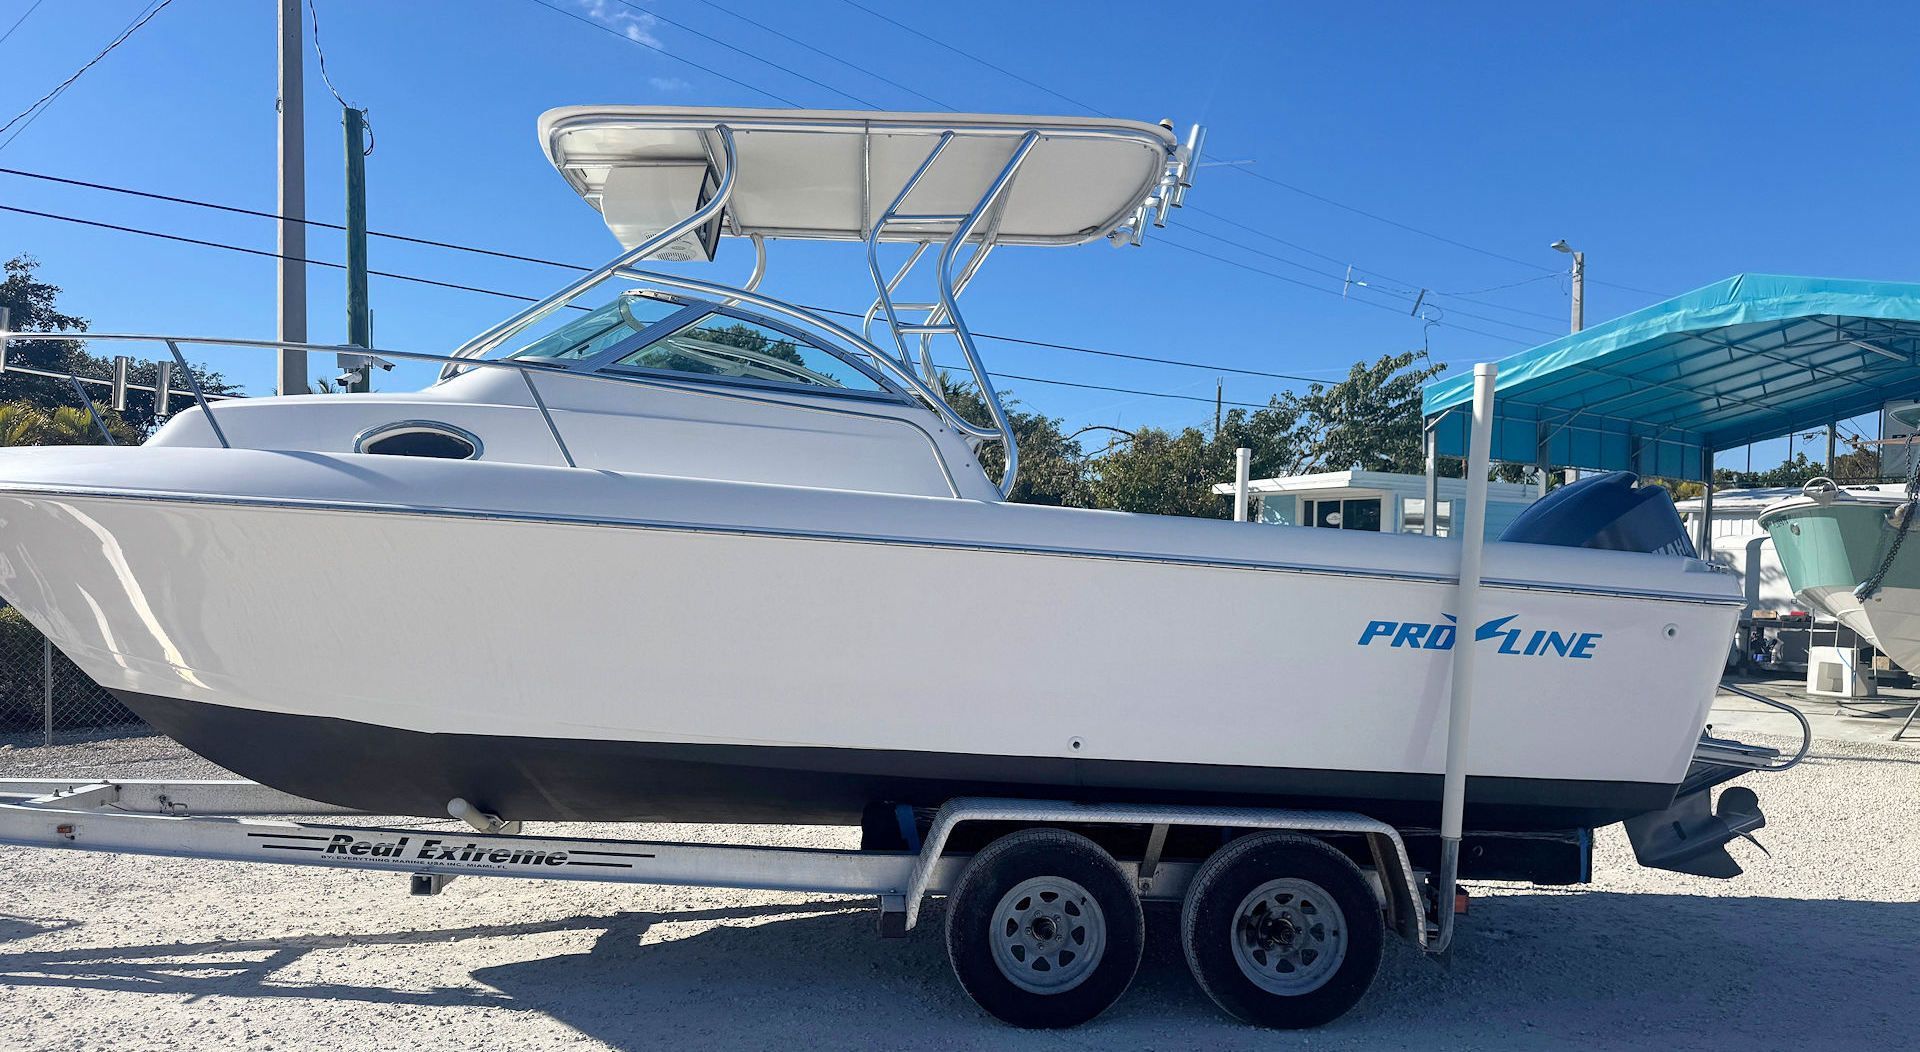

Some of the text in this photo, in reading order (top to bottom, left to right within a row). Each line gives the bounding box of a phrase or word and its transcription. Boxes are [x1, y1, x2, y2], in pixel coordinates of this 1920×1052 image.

[1357, 620, 1602, 659] PRO LINE
[326, 834, 568, 866] Real Extreme
